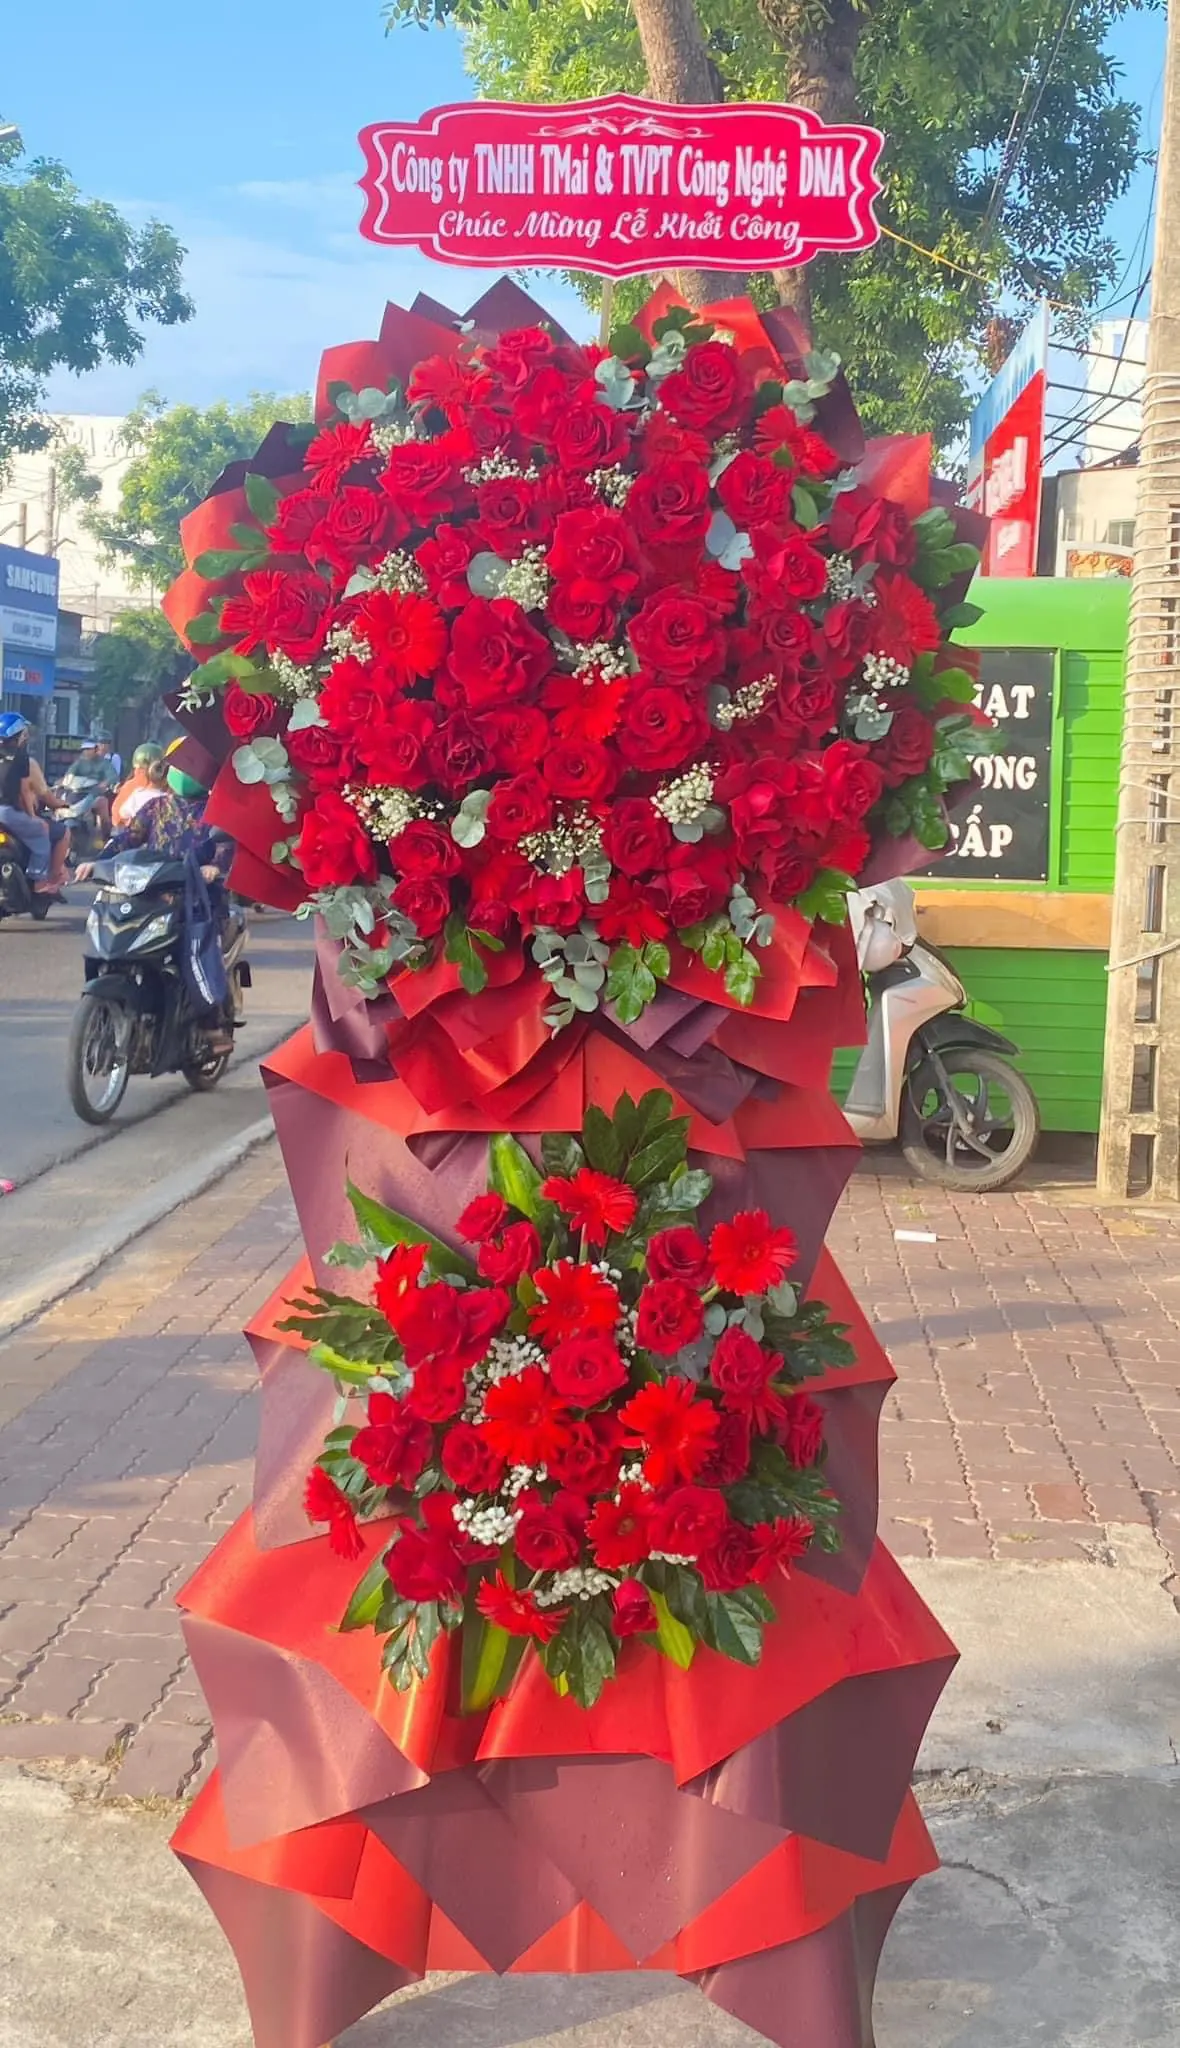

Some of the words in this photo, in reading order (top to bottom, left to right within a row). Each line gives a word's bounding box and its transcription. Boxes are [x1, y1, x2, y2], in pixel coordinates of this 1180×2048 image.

[391, 141, 443, 204] Công
[448, 151, 469, 204] ty
[474, 143, 535, 194] TNHH
[540, 143, 589, 195] TMai
[595, 144, 615, 195] &
[620, 144, 673, 196] TVPT
[677, 145, 730, 208] Công
[734, 145, 788, 208] Nghệ
[798, 145, 847, 197] DNA
[438, 210, 508, 238] Chúc
[513, 211, 602, 249] Mừng
[609, 207, 649, 245] Lễ
[653, 210, 724, 240] Khởi
[730, 212, 801, 250] Công
[6, 564, 56, 596] SAMSUNG
